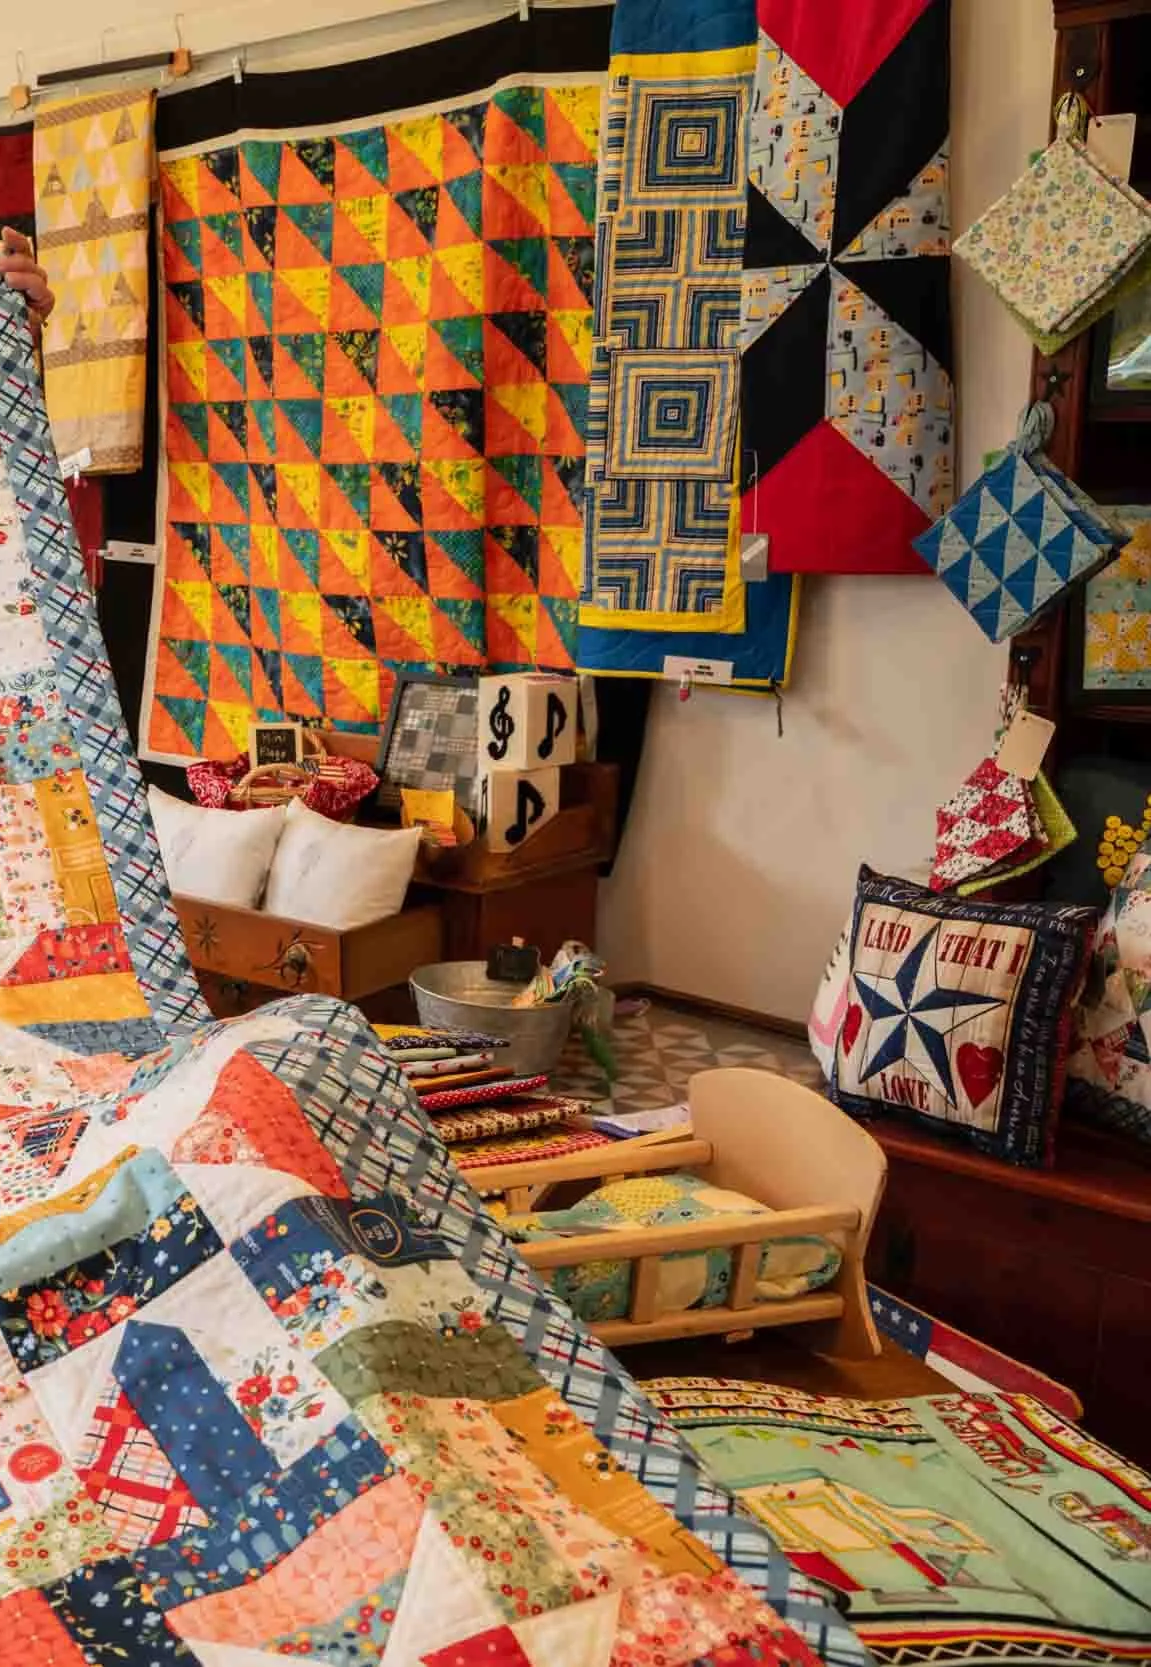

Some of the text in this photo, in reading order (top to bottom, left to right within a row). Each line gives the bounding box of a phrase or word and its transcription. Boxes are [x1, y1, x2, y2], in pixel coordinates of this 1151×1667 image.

[863, 919, 1025, 975] LAND THAT I
[880, 1073, 930, 1111] LOVE
